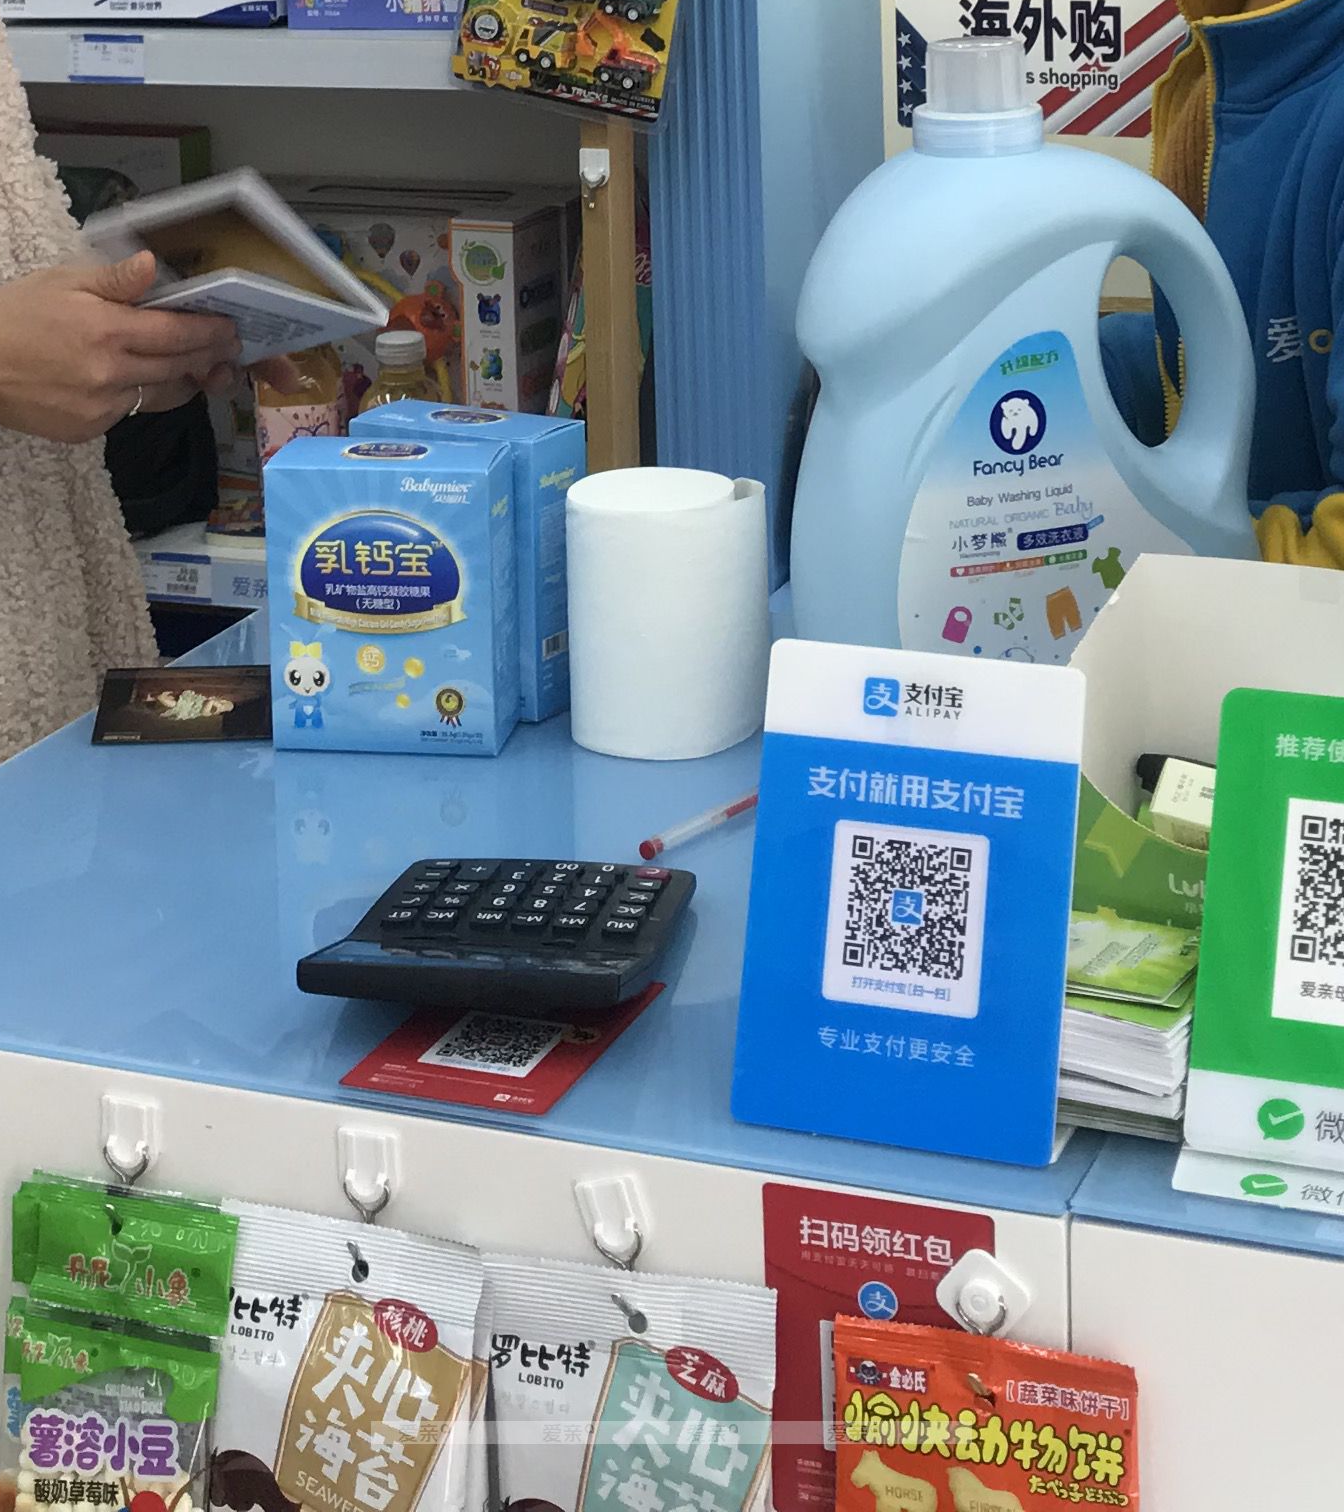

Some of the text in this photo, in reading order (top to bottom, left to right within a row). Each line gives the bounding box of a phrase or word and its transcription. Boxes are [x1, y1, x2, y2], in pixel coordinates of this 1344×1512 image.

[1037, 65, 1120, 91] shopping
[973, 453, 1065, 477] Fancy Bear
[966, 483, 1073, 507] Baby Washing Liquid
[949, 516, 999, 529] NATURAL
[1004, 509, 1049, 524] ORGANIC
[314, 539, 434, 578] 乳钙宝
[904, 682, 964, 709] 支付宝
[905, 706, 962, 721] ALIPAY
[807, 765, 1026, 820] 支付就用支付宝
[817, 1025, 977, 1069] 专业支付更安全
[799, 1215, 954, 1267] 扫码领红包
[230, 1288, 303, 1330] 比特
[382, 1307, 431, 1348] 核桃
[230, 1324, 275, 1342] LOBITO
[490, 1333, 592, 1377] 罗比特
[311, 1321, 440, 1439] 夹心
[517, 1373, 565, 1390] LOBITO
[674, 1351, 731, 1402] 芝麻
[888, 1368, 927, 1395] 金必氏
[28, 1415, 177, 1478] 薯溶小豆
[612, 1375, 749, 1488] 夹心
[843, 1389, 1126, 1489] 愉快动物饼
[296, 1407, 417, 1509] 海苔
[34, 1478, 120, 1509] 酸奶草莓味
[884, 1484, 925, 1502] HORSE
